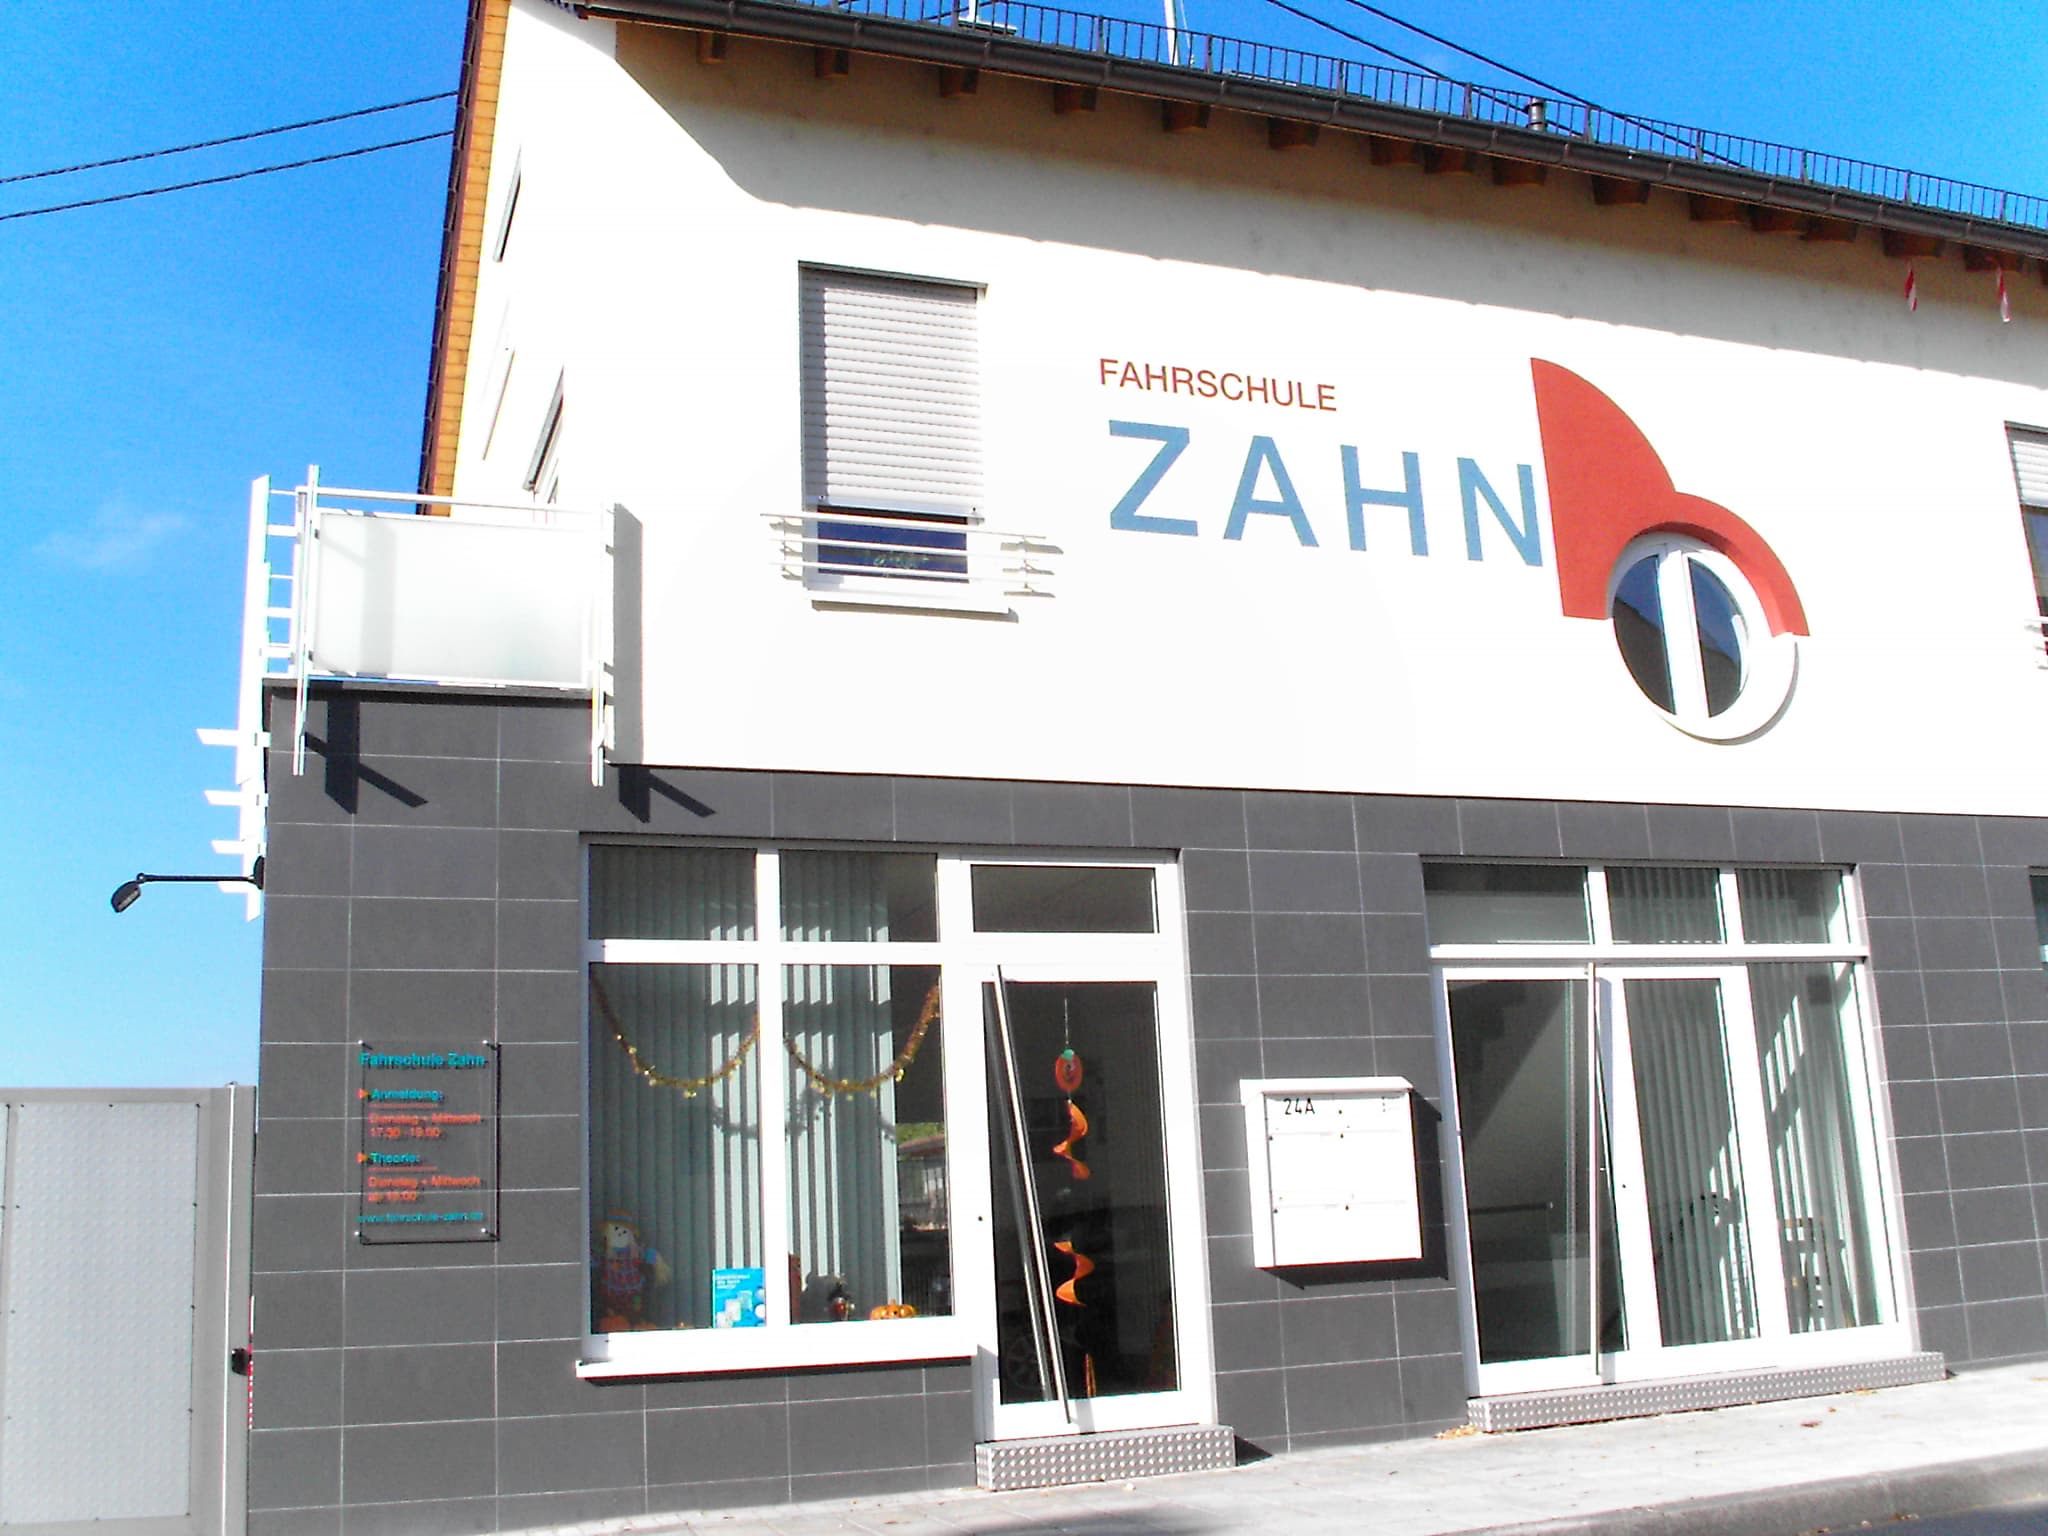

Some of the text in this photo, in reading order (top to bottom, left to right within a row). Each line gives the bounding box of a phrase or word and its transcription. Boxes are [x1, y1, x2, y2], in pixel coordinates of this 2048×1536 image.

[1099, 357, 1337, 412] FAHRSCHULE
[1108, 419, 1544, 568] ZAHN
[360, 1052, 485, 1067] Fahrschule Zahn
[1283, 1097, 1316, 1116] 24A
